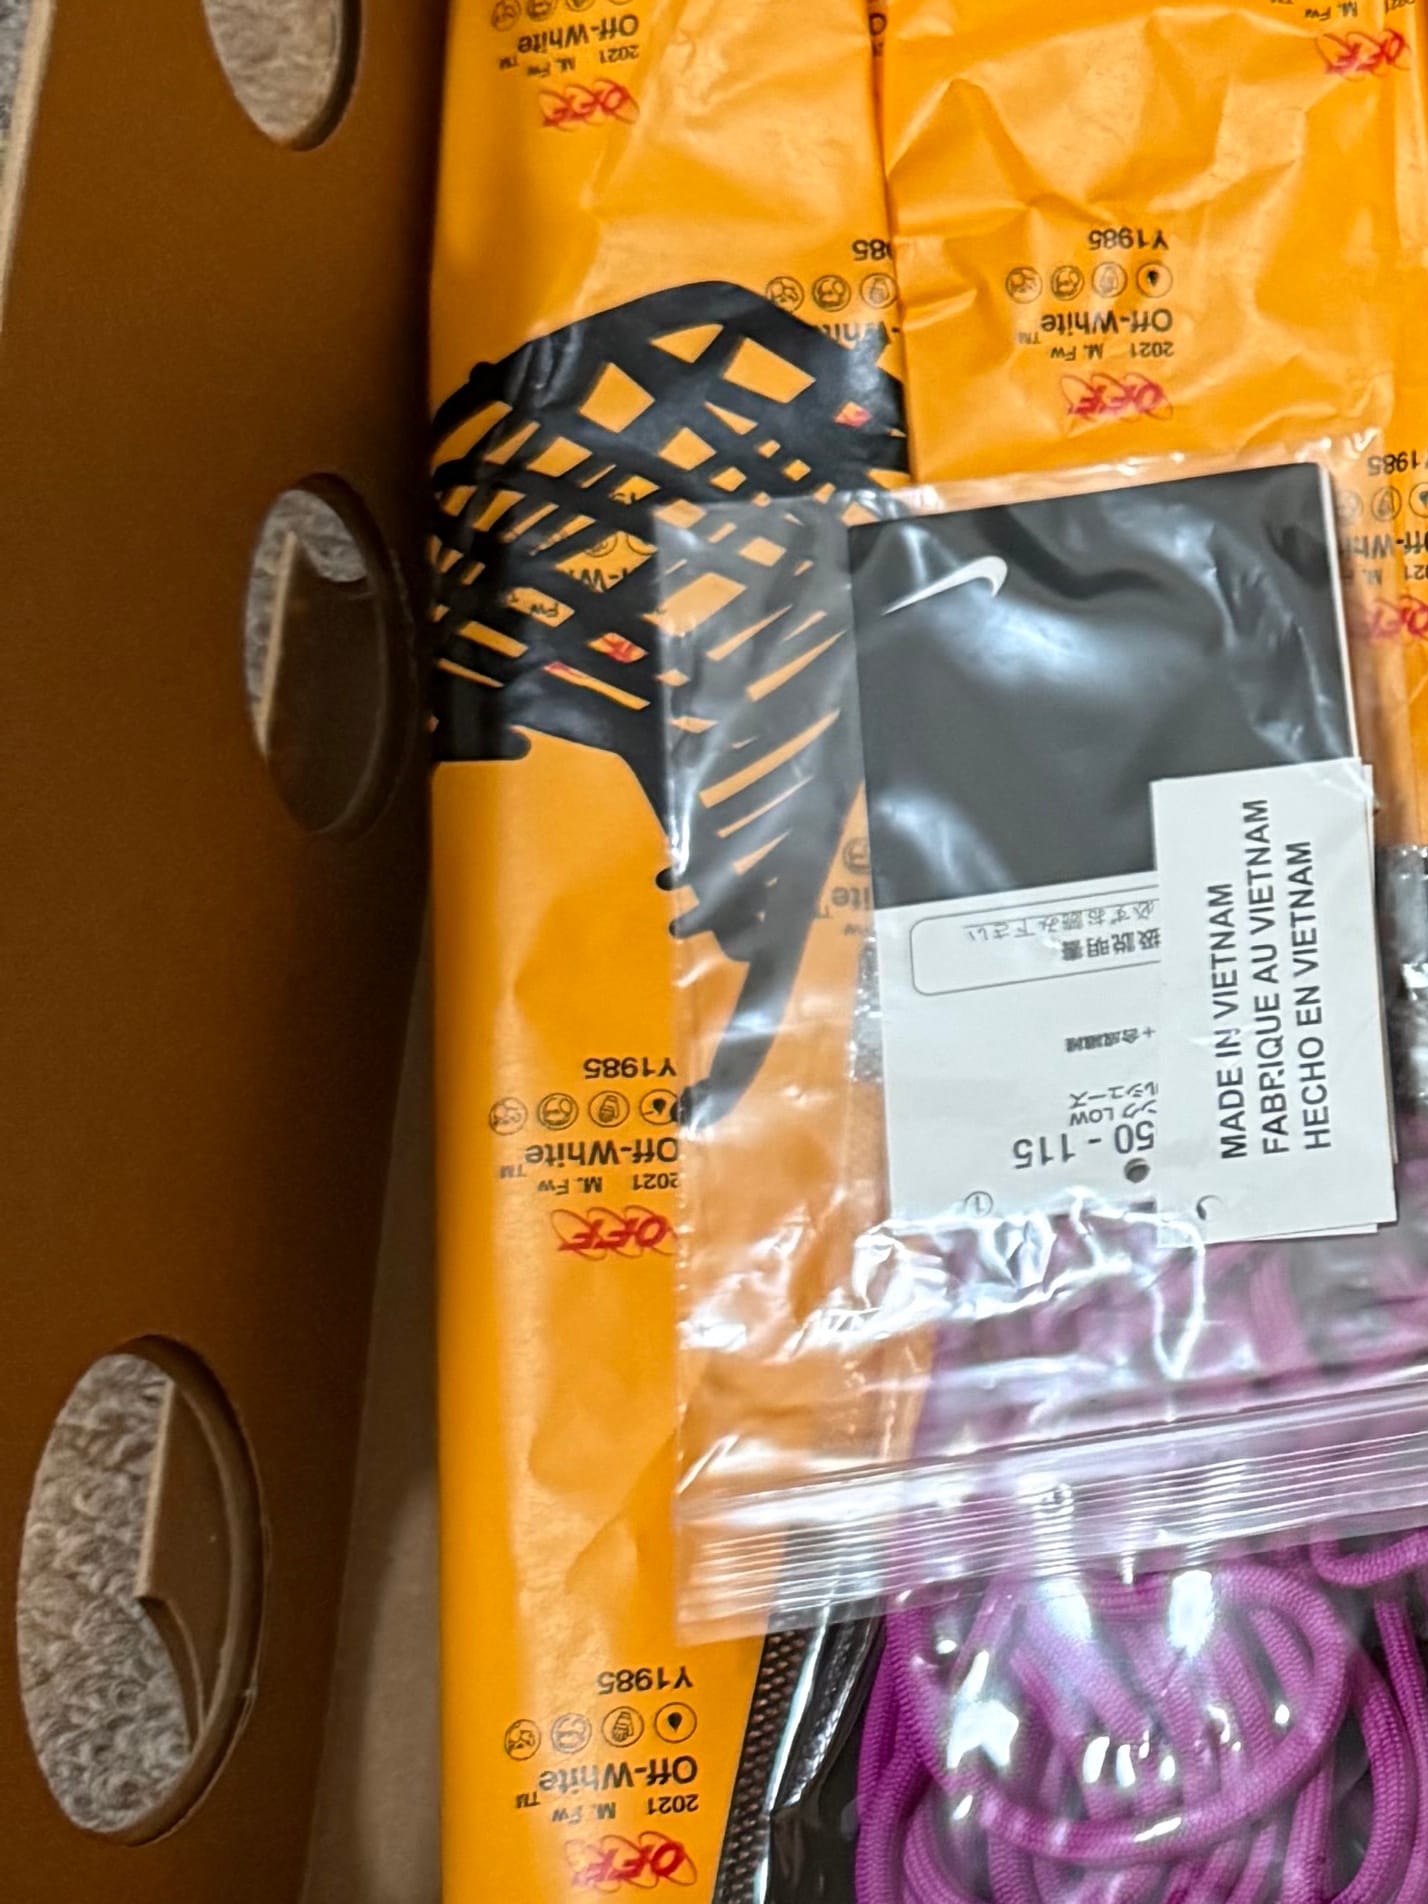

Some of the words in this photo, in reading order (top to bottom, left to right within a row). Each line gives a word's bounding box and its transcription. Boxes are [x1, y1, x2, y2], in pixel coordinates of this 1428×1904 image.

[517, 14, 640, 55] Off-White
[1088, 228, 1169, 251] Y1985
[1041, 309, 1173, 335] Off-White
[1242, 799, 1275, 936] VIETNAM
[1286, 841, 1319, 977] VIETNAM
[1207, 883, 1240, 1020] VIETNAM
[1250, 943, 1280, 984] AU
[1293, 984, 1323, 1027] EN
[1214, 1028, 1242, 1058] IN
[584, 1057, 677, 1079] Y1985
[1254, 992, 1290, 1155] FABRIQUE
[1298, 1036, 1332, 1150] HECHO
[1069, 1108, 1114, 1126] LOW
[1216, 1067, 1248, 1159] MADE
[525, 1138, 678, 1163] Off-White
[1013, 1133, 1076, 1169] 115
[597, 1665, 693, 1695] Y1985
[540, 1756, 697, 1789] Off-White
